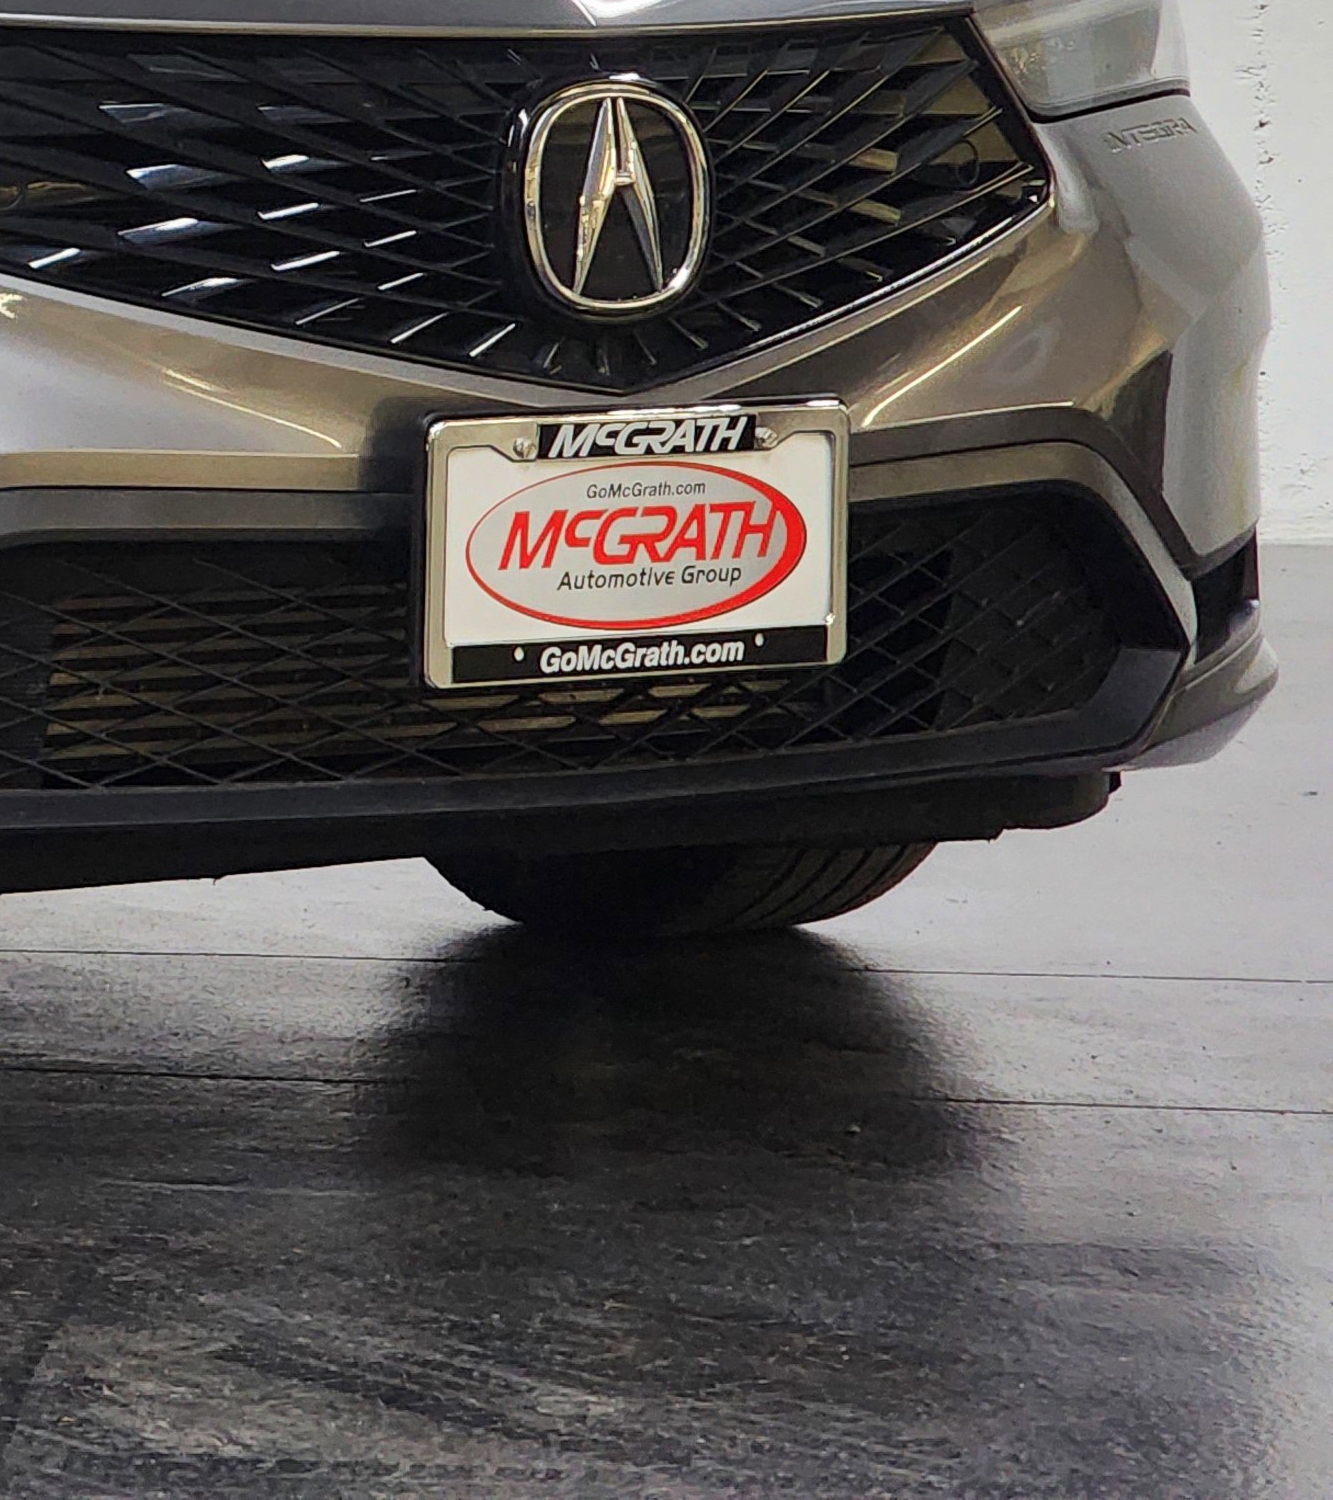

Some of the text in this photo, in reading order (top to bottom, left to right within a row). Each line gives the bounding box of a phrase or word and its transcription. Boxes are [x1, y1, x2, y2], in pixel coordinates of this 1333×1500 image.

[586, 480, 707, 500] GoMcGrath.com
[557, 564, 743, 591] Automotive Group
[539, 637, 745, 674] GoMcGrath.com
